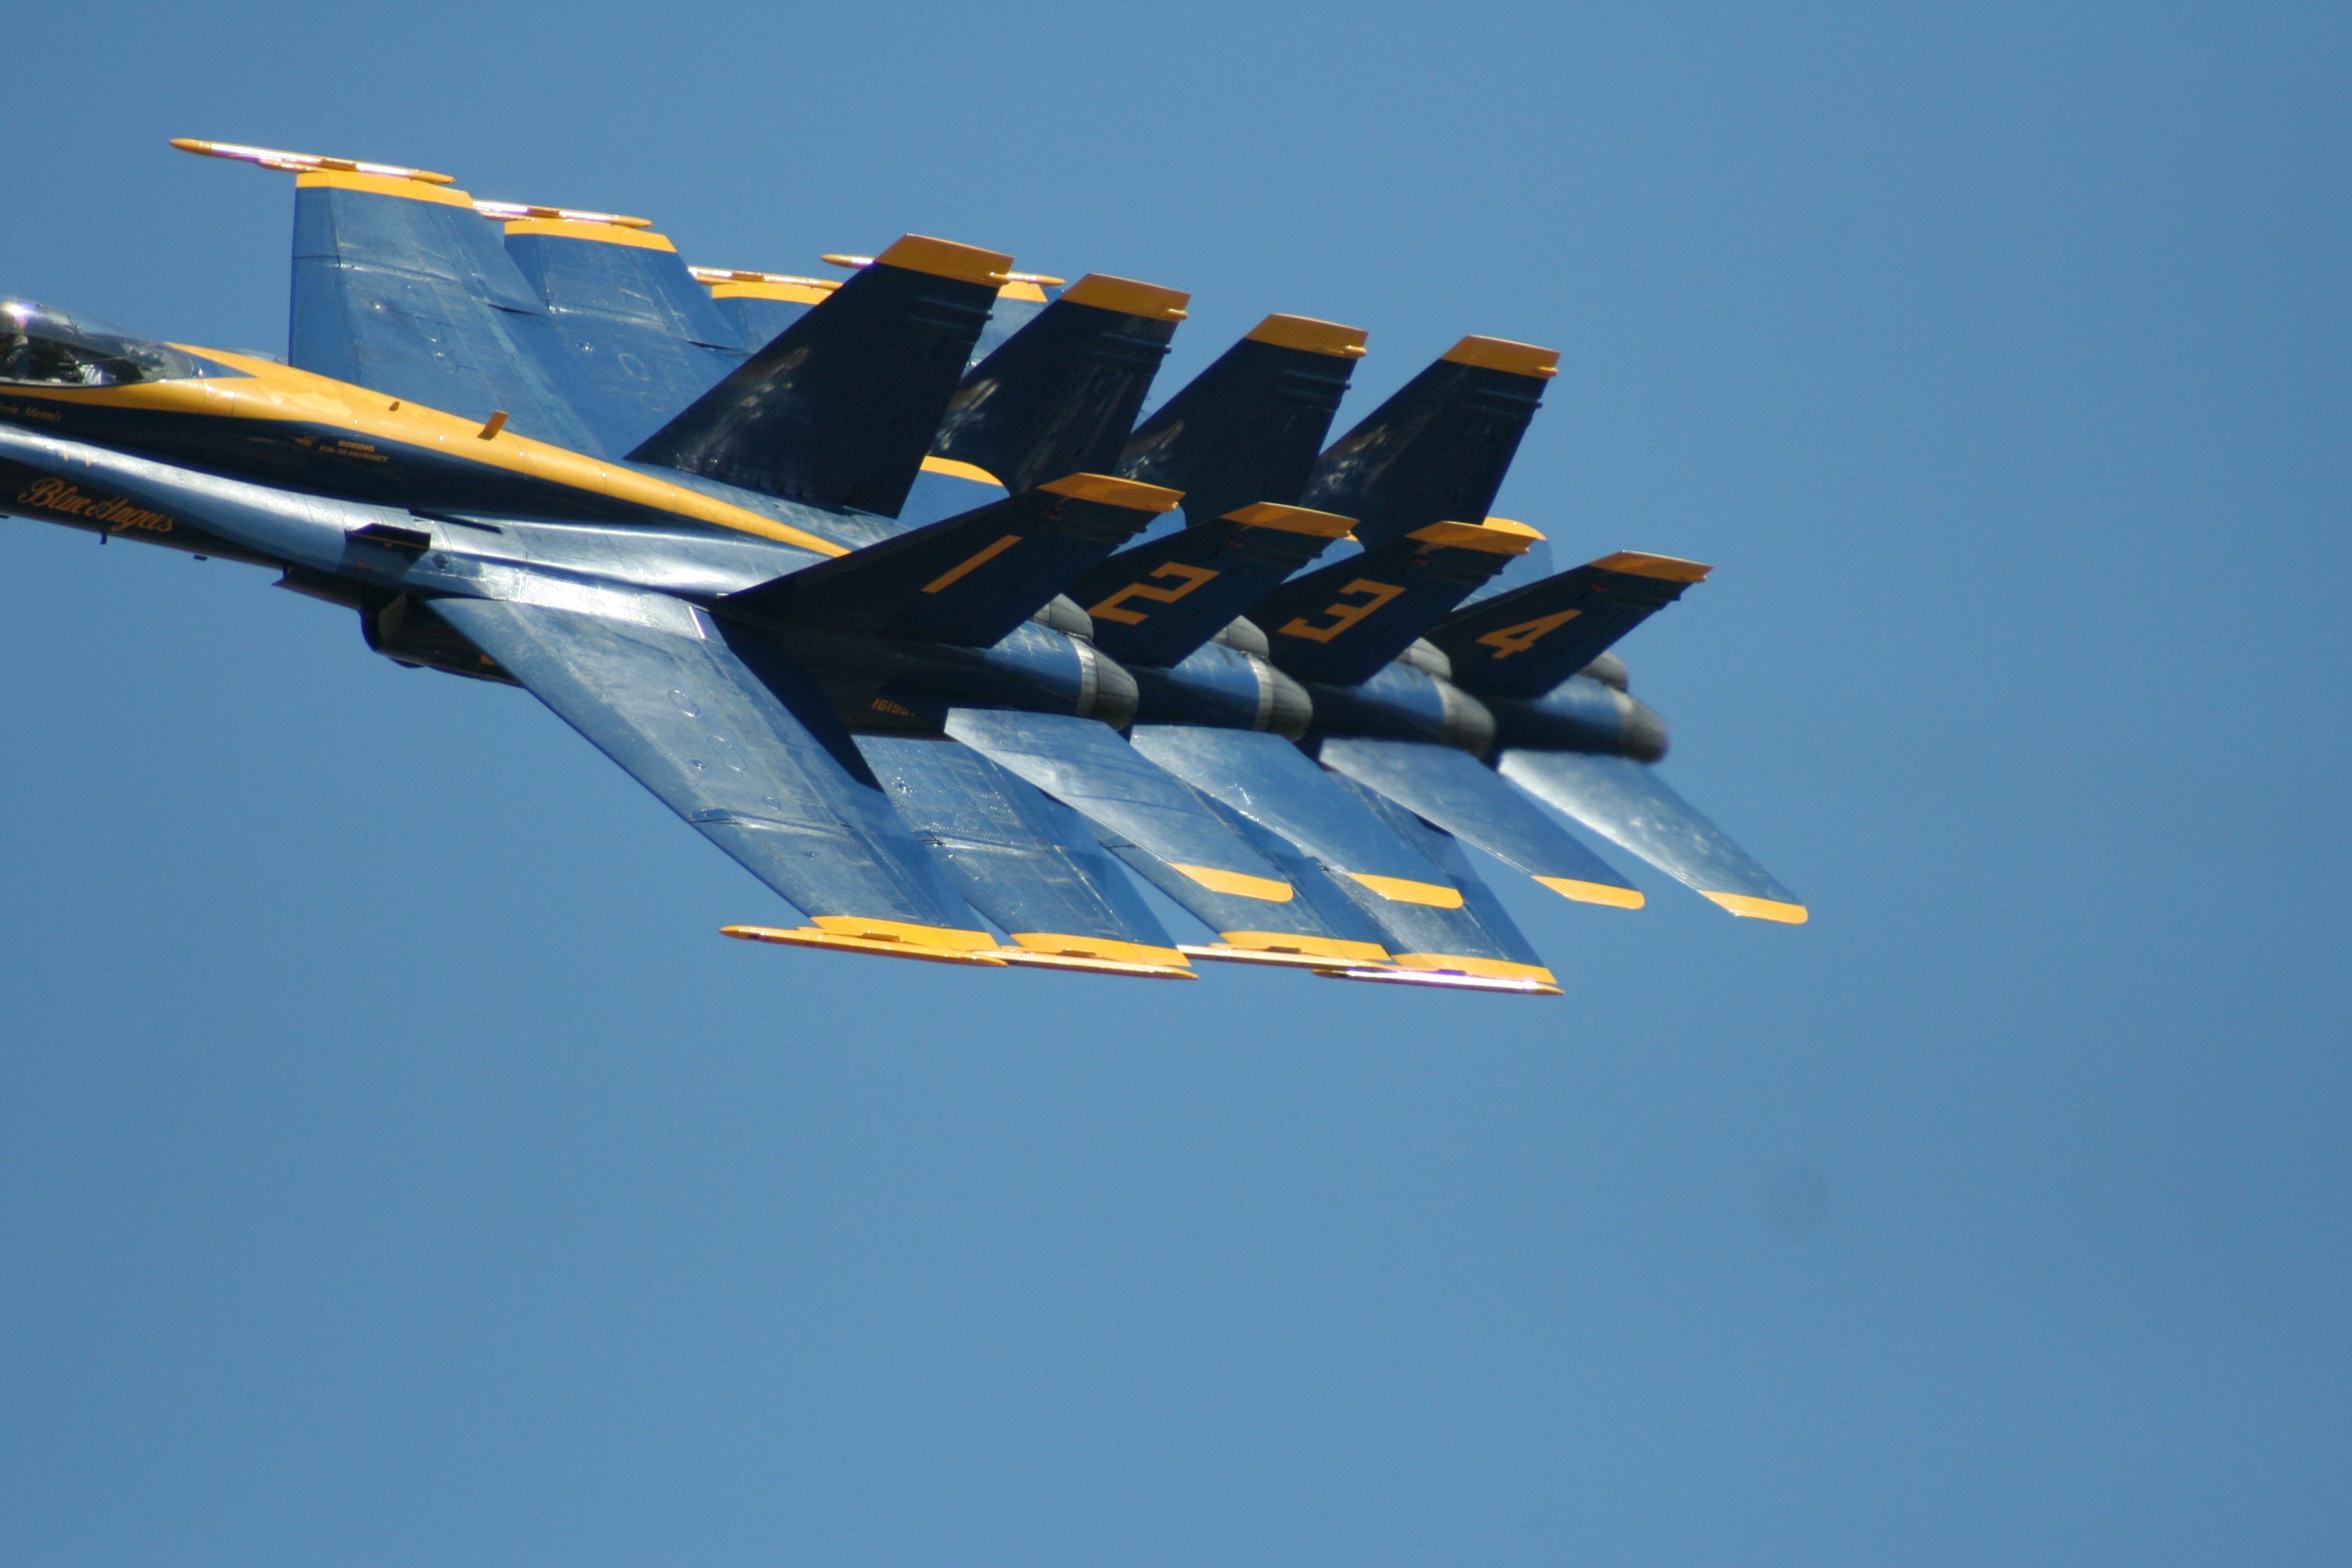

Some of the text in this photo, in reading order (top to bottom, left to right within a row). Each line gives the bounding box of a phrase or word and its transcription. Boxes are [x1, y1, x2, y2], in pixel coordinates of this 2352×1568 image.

[338, 440, 376, 452] BOEING
[348, 450, 389, 461] HORNET
[18, 477, 174, 532] Blue Angels
[921, 534, 1023, 593] 1
[1087, 561, 1221, 626] 2
[1278, 578, 1407, 643] 3
[1475, 608, 1583, 659] 4
